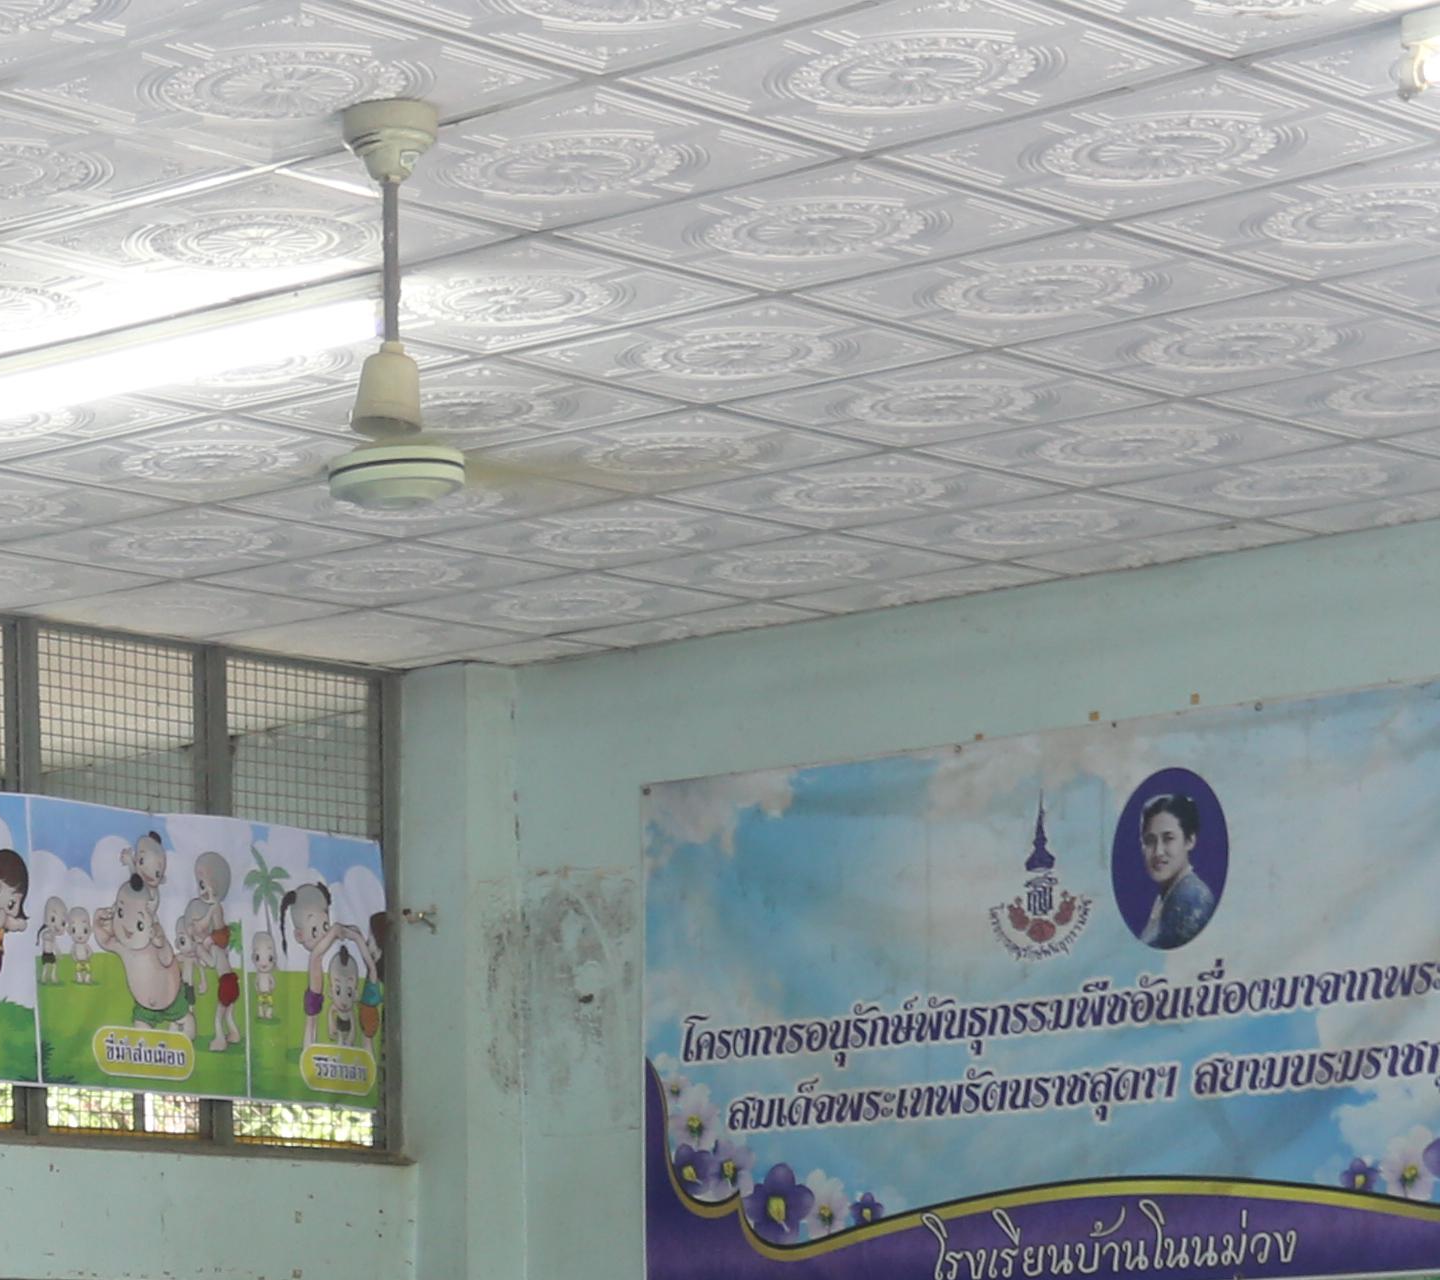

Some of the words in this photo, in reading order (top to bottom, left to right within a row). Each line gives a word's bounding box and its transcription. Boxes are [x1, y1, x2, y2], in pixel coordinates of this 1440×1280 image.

[104, 1035, 186, 1067] ขี่ม้าส่งเมือง
[727, 1060, 1179, 1133] สมเด็จพระเทพรัตนราชสุดาฯ
